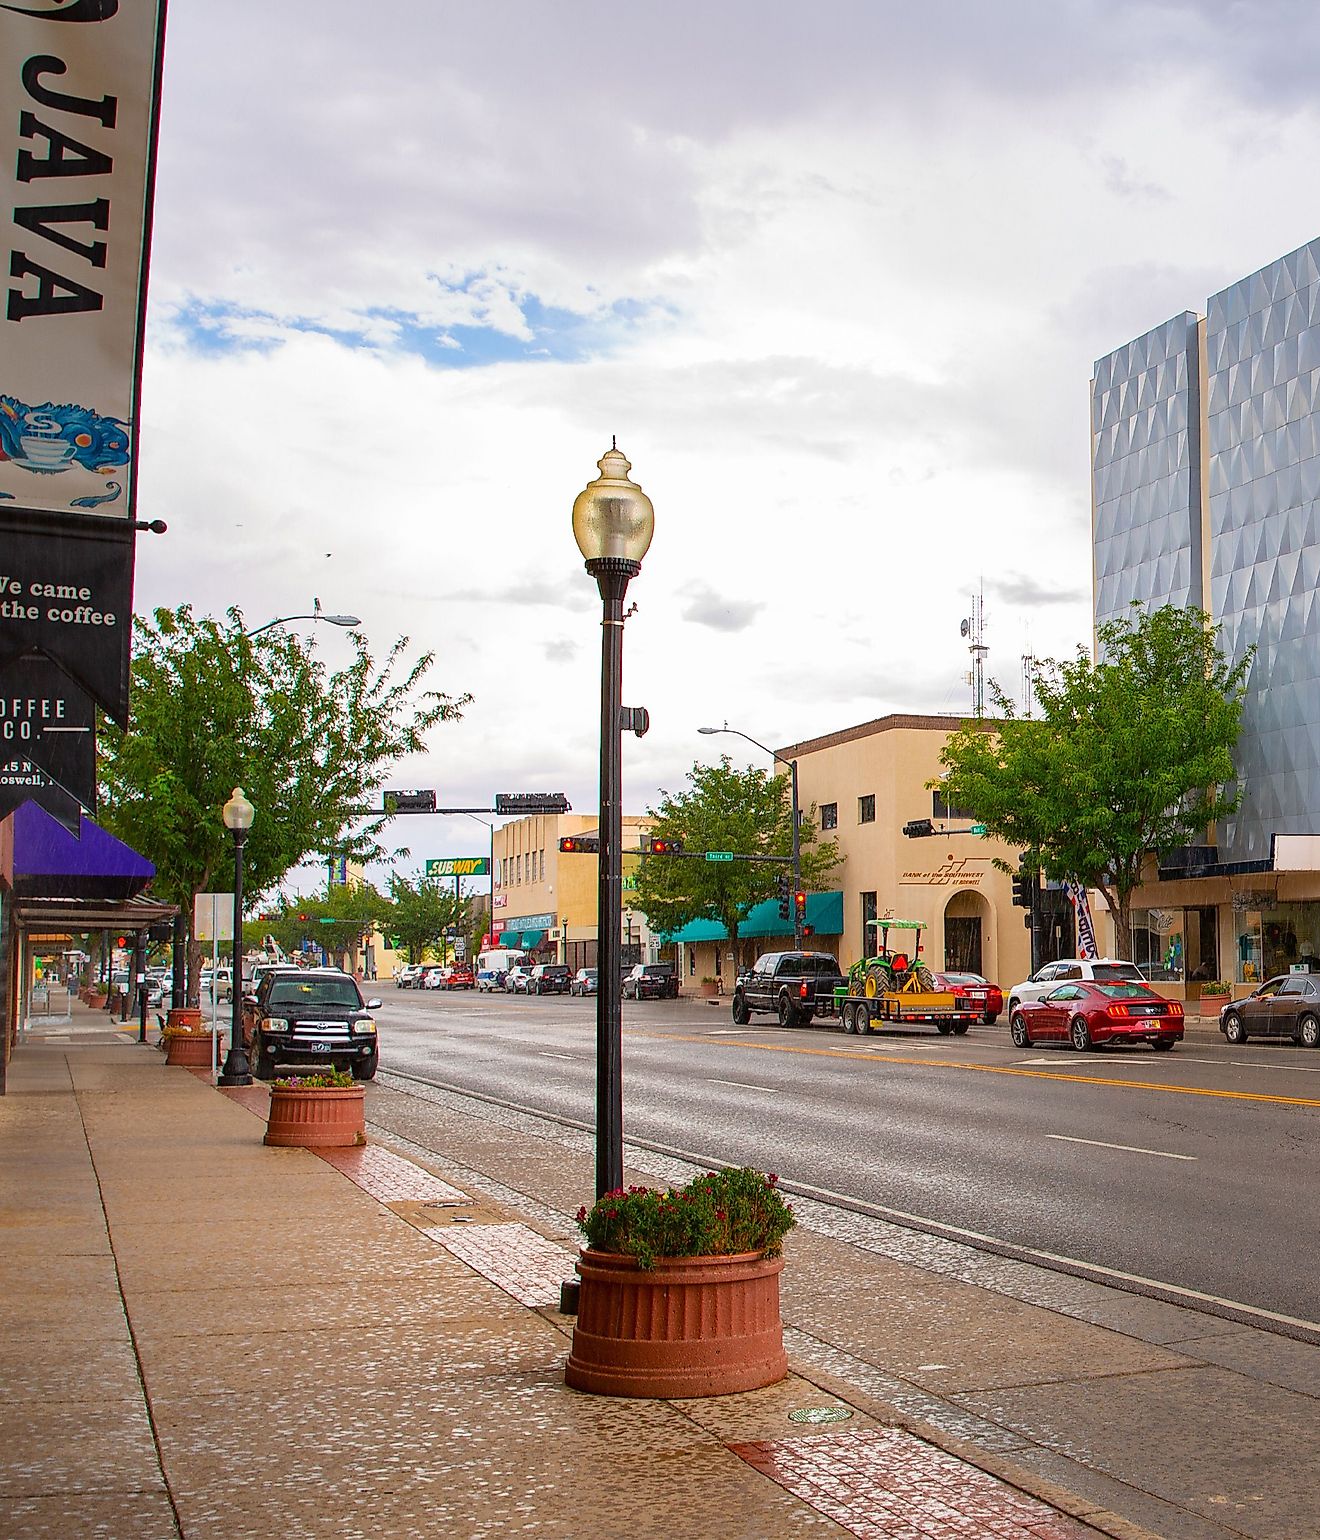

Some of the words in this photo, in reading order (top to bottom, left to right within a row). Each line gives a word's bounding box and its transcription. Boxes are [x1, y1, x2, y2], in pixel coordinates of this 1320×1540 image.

[7, 54, 118, 322] JAVA
[29, 582, 92, 601] came
[1, 600, 39, 619] the
[47, 606, 116, 626] coffee
[4, 721, 40, 740] CO.
[0, 775, 45, 787] oswell,
[428, 859, 482, 875] SUBWAY
